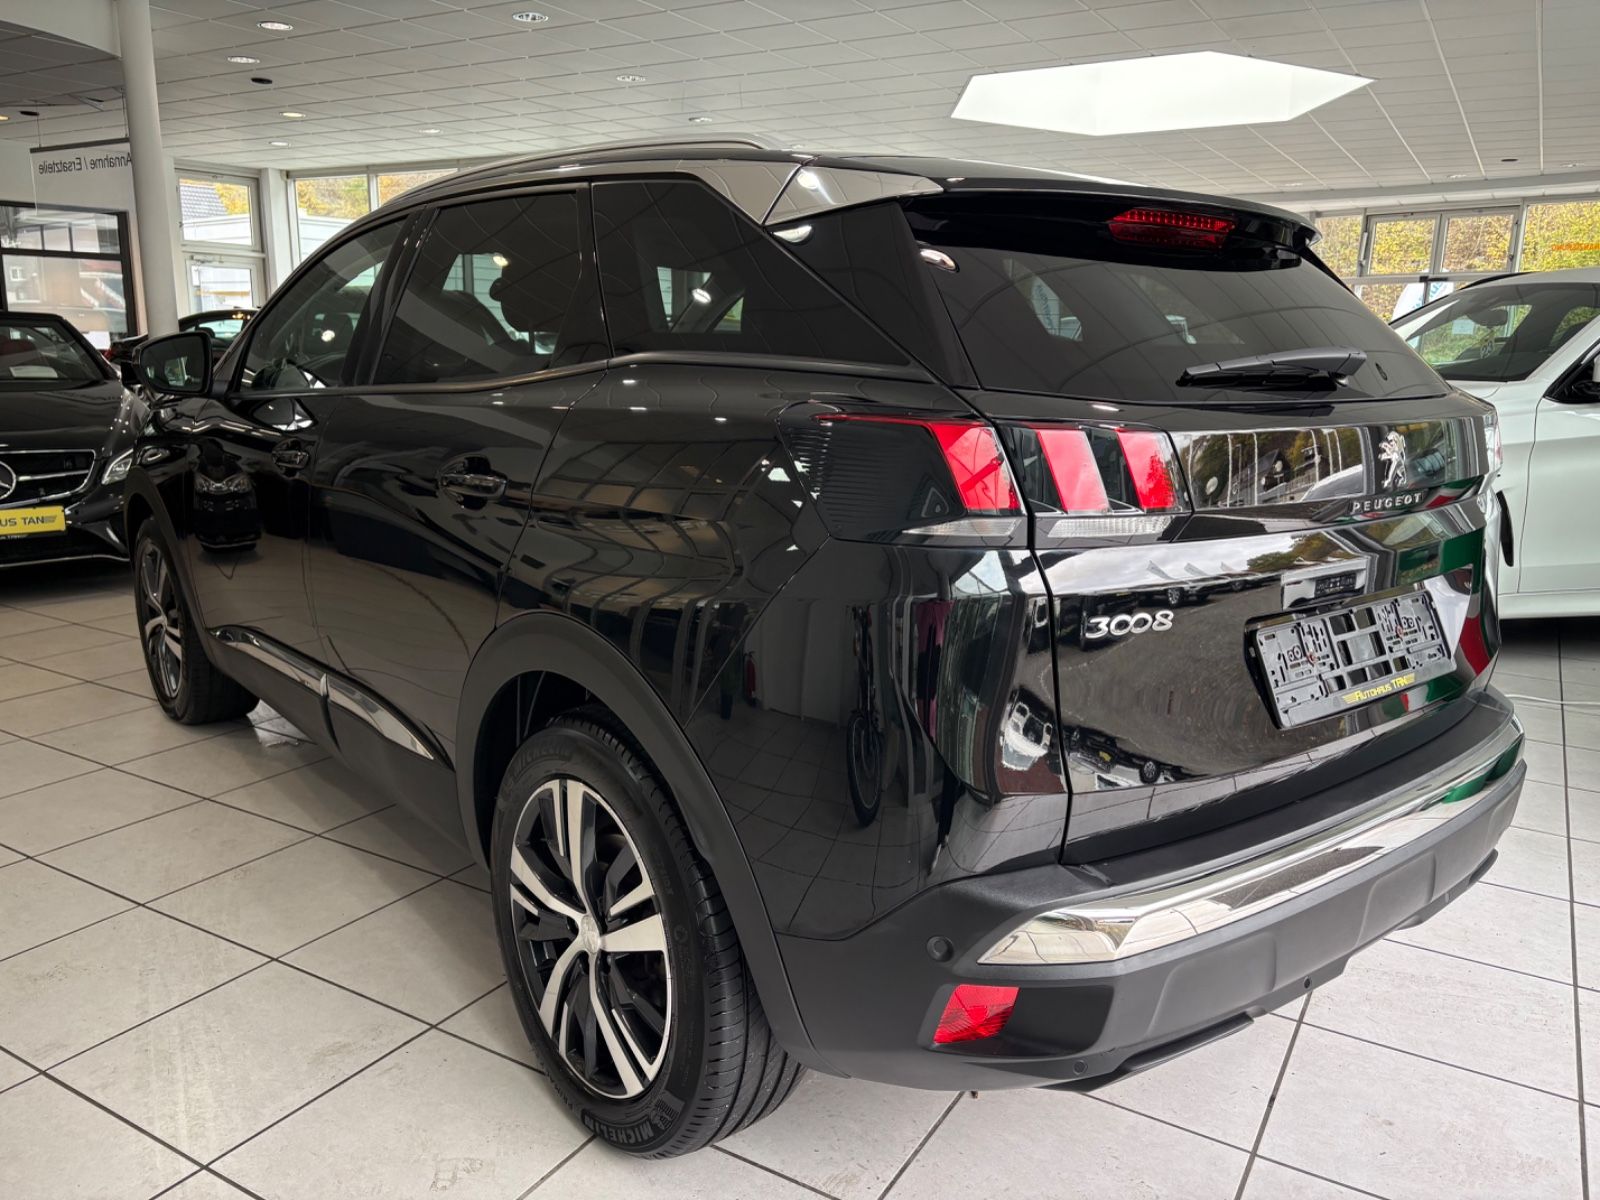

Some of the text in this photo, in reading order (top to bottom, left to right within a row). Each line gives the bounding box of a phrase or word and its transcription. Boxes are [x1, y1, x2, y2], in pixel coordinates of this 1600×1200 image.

[1351, 492, 1422, 513] PEUGEOT
[21, 516, 45, 525] TAN
[1085, 609, 1174, 639] 3008
